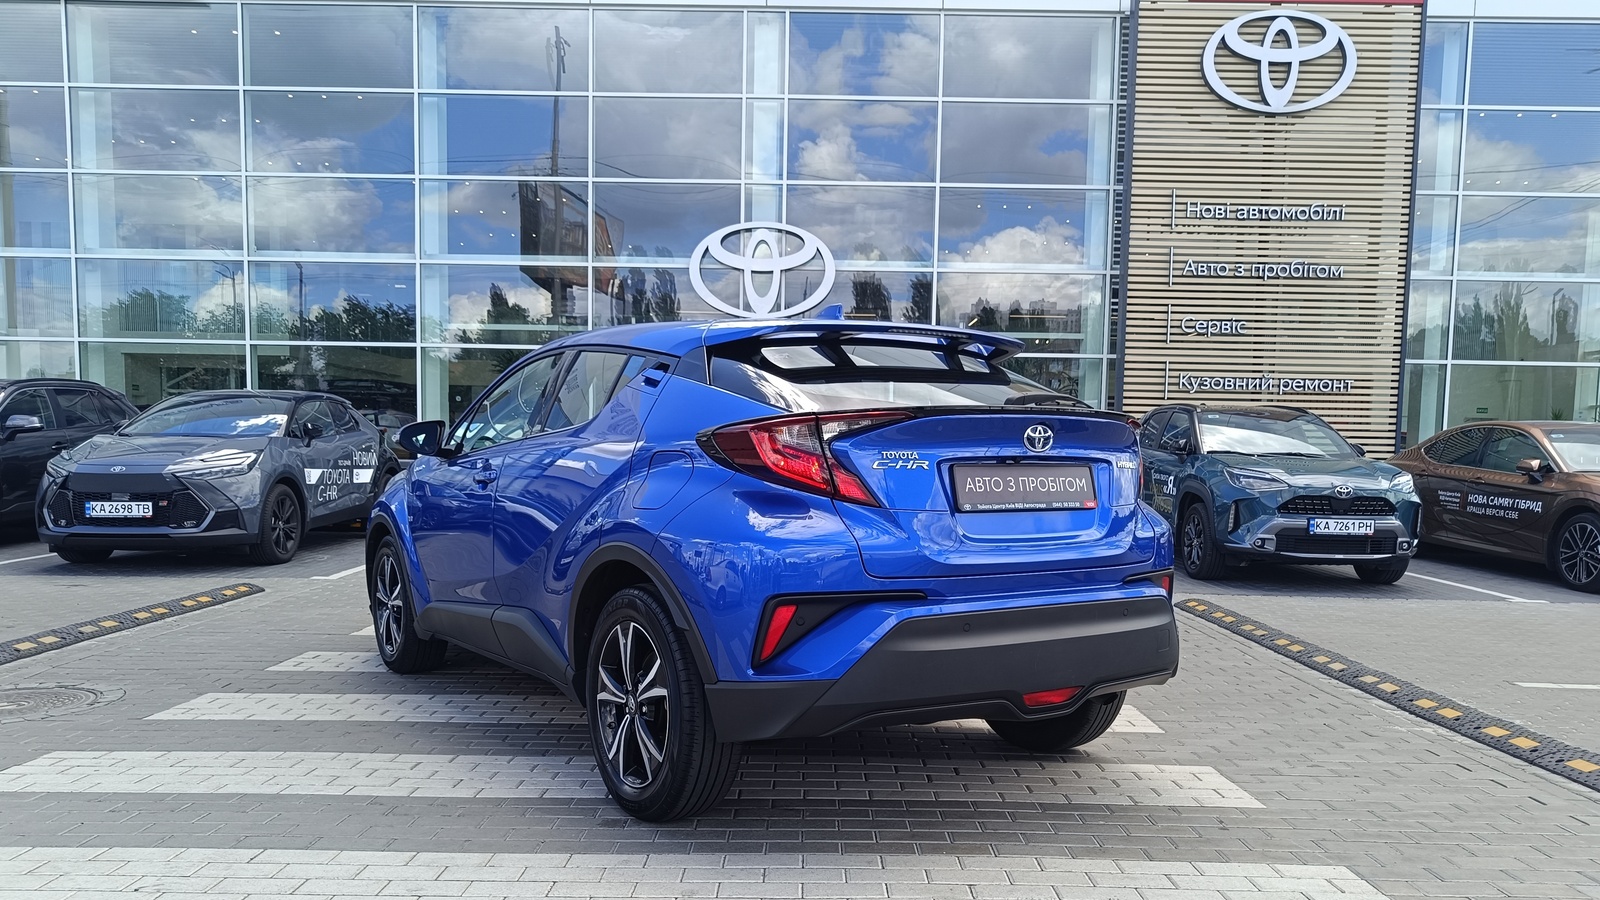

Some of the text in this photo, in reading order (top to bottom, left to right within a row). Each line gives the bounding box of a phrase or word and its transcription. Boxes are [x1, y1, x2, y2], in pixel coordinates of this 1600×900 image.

[1186, 201, 1346, 222] Нові автомобілі
[1183, 258, 1345, 281] Авто з пробігом
[1181, 316, 1248, 337] Сервіс
[1178, 373, 1355, 395] Кузовний ремонт
[881, 451, 919, 459] TOYOTA
[872, 460, 930, 470] C-HR
[323, 468, 351, 484] TOYOTA
[965, 477, 1087, 492] АВТО З ПРОБІГОМ
[317, 485, 338, 501] C-HR
[91, 503, 107, 514] KA
[108, 503, 133, 514] 2698
[135, 503, 151, 514] TB
[1467, 494, 1542, 513] НОВА CAMRY ГІБРИД
[1466, 505, 1519, 519] КРАЩА ВЕРСІЯ СЕБЕ
[1315, 521, 1372, 531] KA 7261 PH
